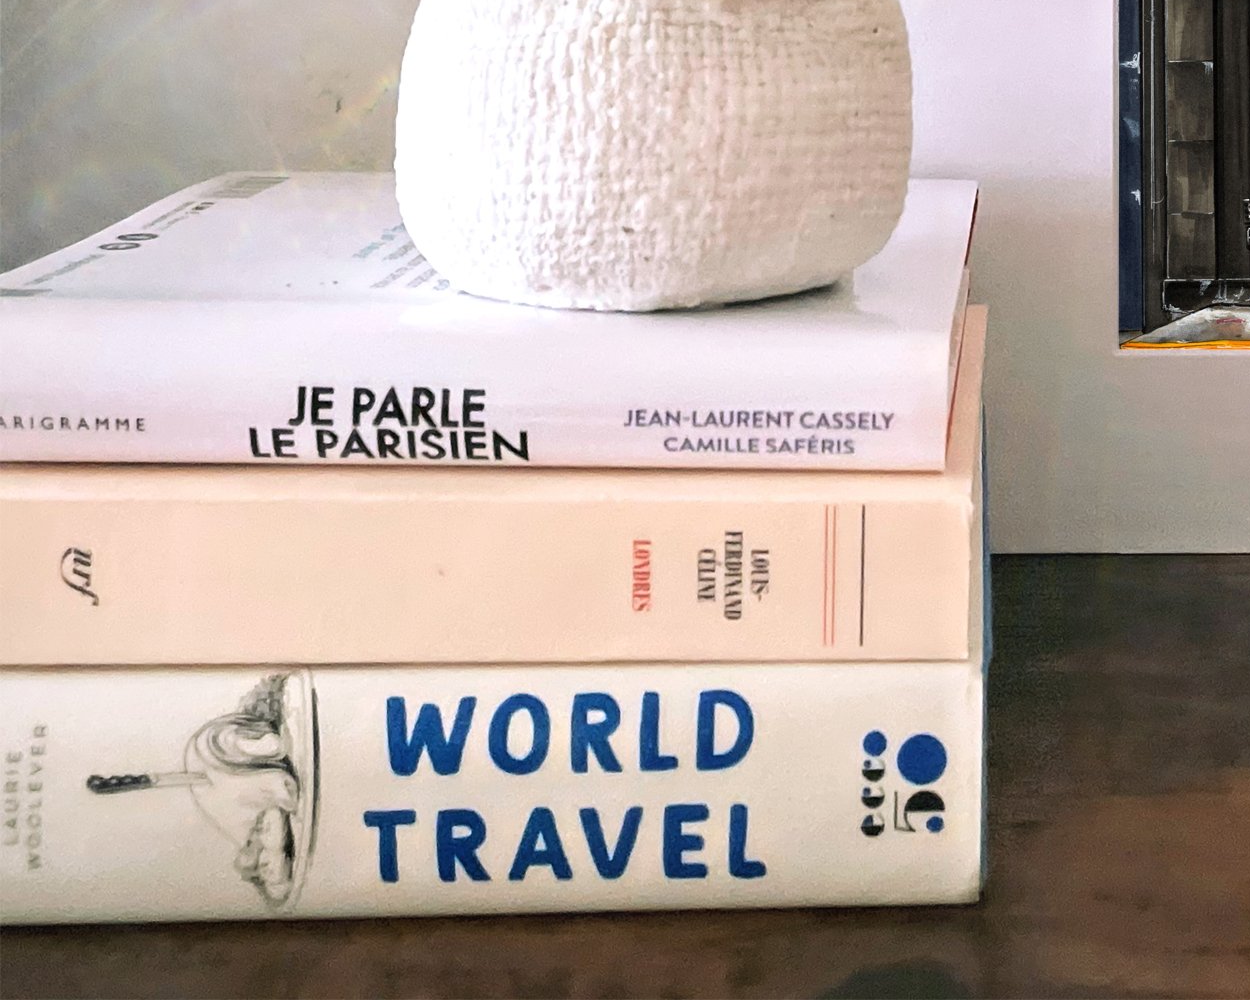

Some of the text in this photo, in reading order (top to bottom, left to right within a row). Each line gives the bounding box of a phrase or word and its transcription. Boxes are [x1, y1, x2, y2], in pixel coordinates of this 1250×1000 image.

[249, 427, 530, 461] LE PARISIEN
[288, 386, 486, 428] JE PARLE
[624, 409, 895, 431] JEAN-LAURENT CASSELY
[663, 435, 855, 455] CAMILLE SAFÉRIS
[632, 540, 651, 611] LONDRES
[724, 531, 743, 620] FERDINAND
[386, 689, 755, 776] WORLD
[4, 751, 23, 846] LAURIE
[27, 726, 47, 870] WOOLEVER
[363, 804, 768, 884] TRAVEL
